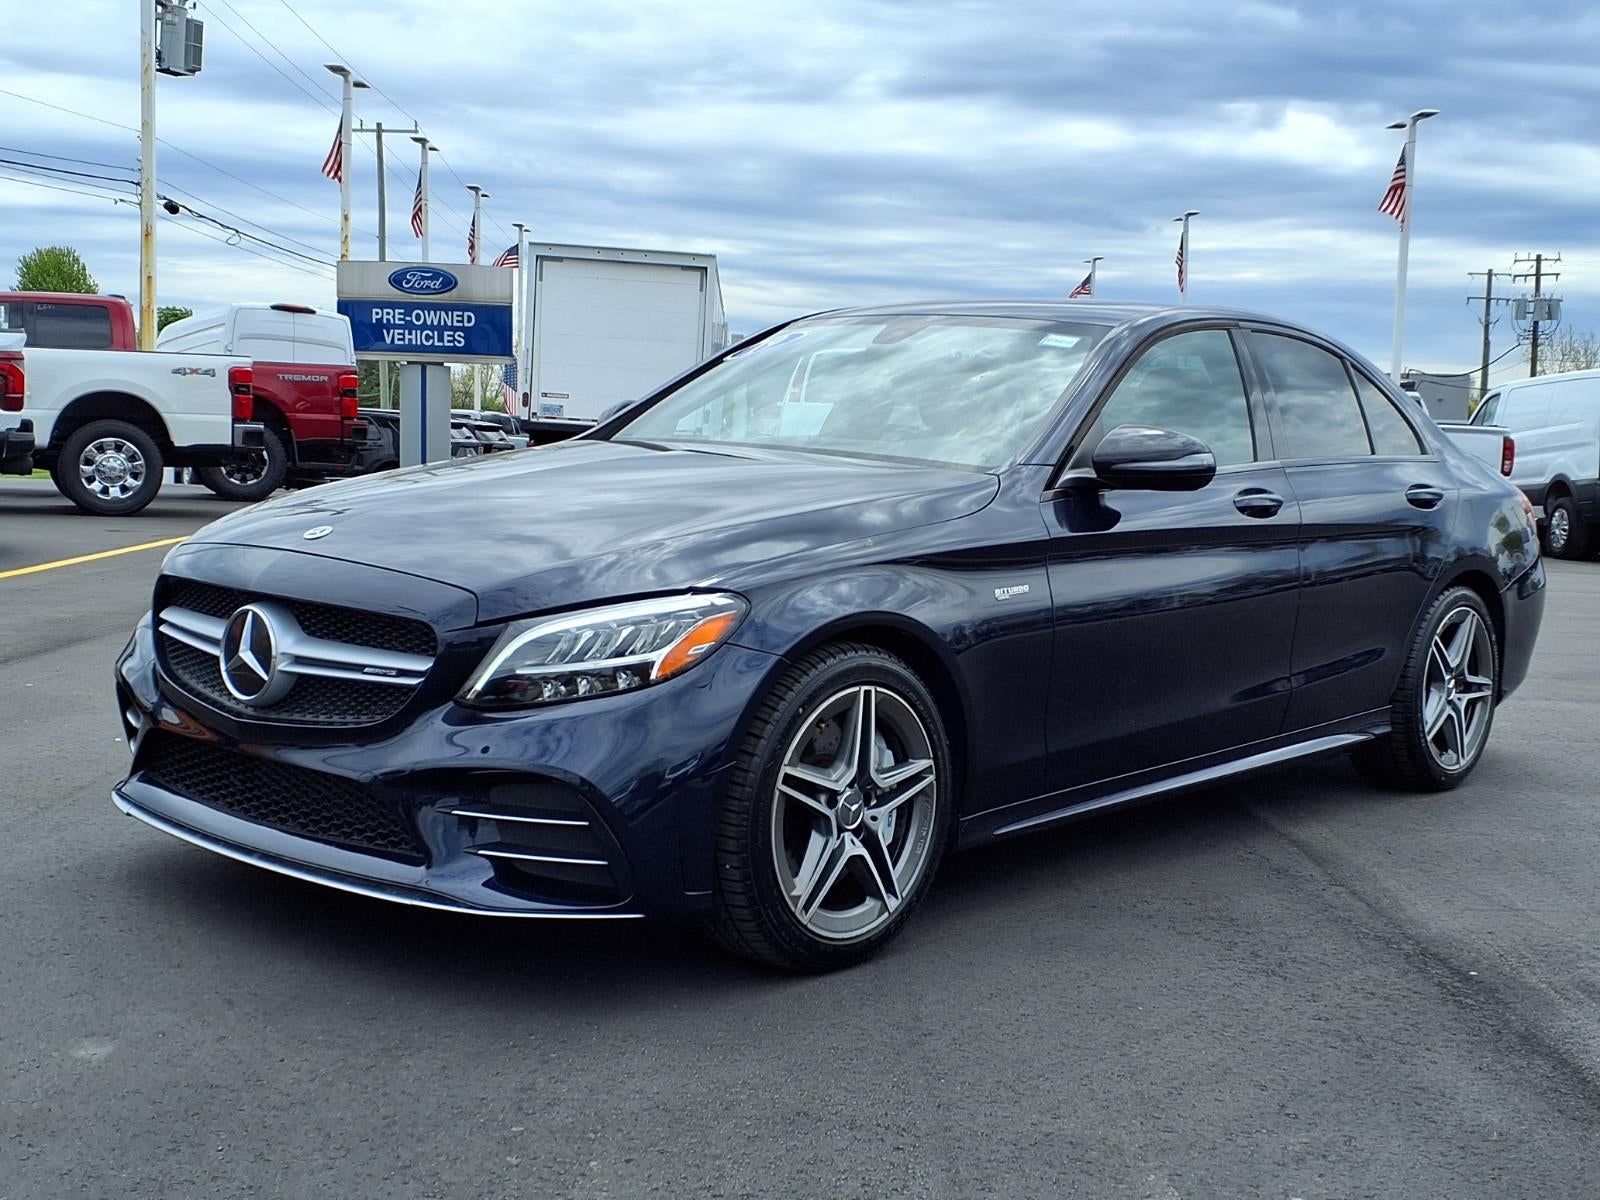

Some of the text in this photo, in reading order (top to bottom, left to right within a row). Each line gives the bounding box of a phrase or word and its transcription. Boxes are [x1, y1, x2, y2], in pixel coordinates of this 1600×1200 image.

[402, 270, 444, 289] Ford
[372, 308, 476, 327] PRE-OWNED
[383, 329, 465, 347] VEHICLES
[276, 373, 329, 382] TREMOR
